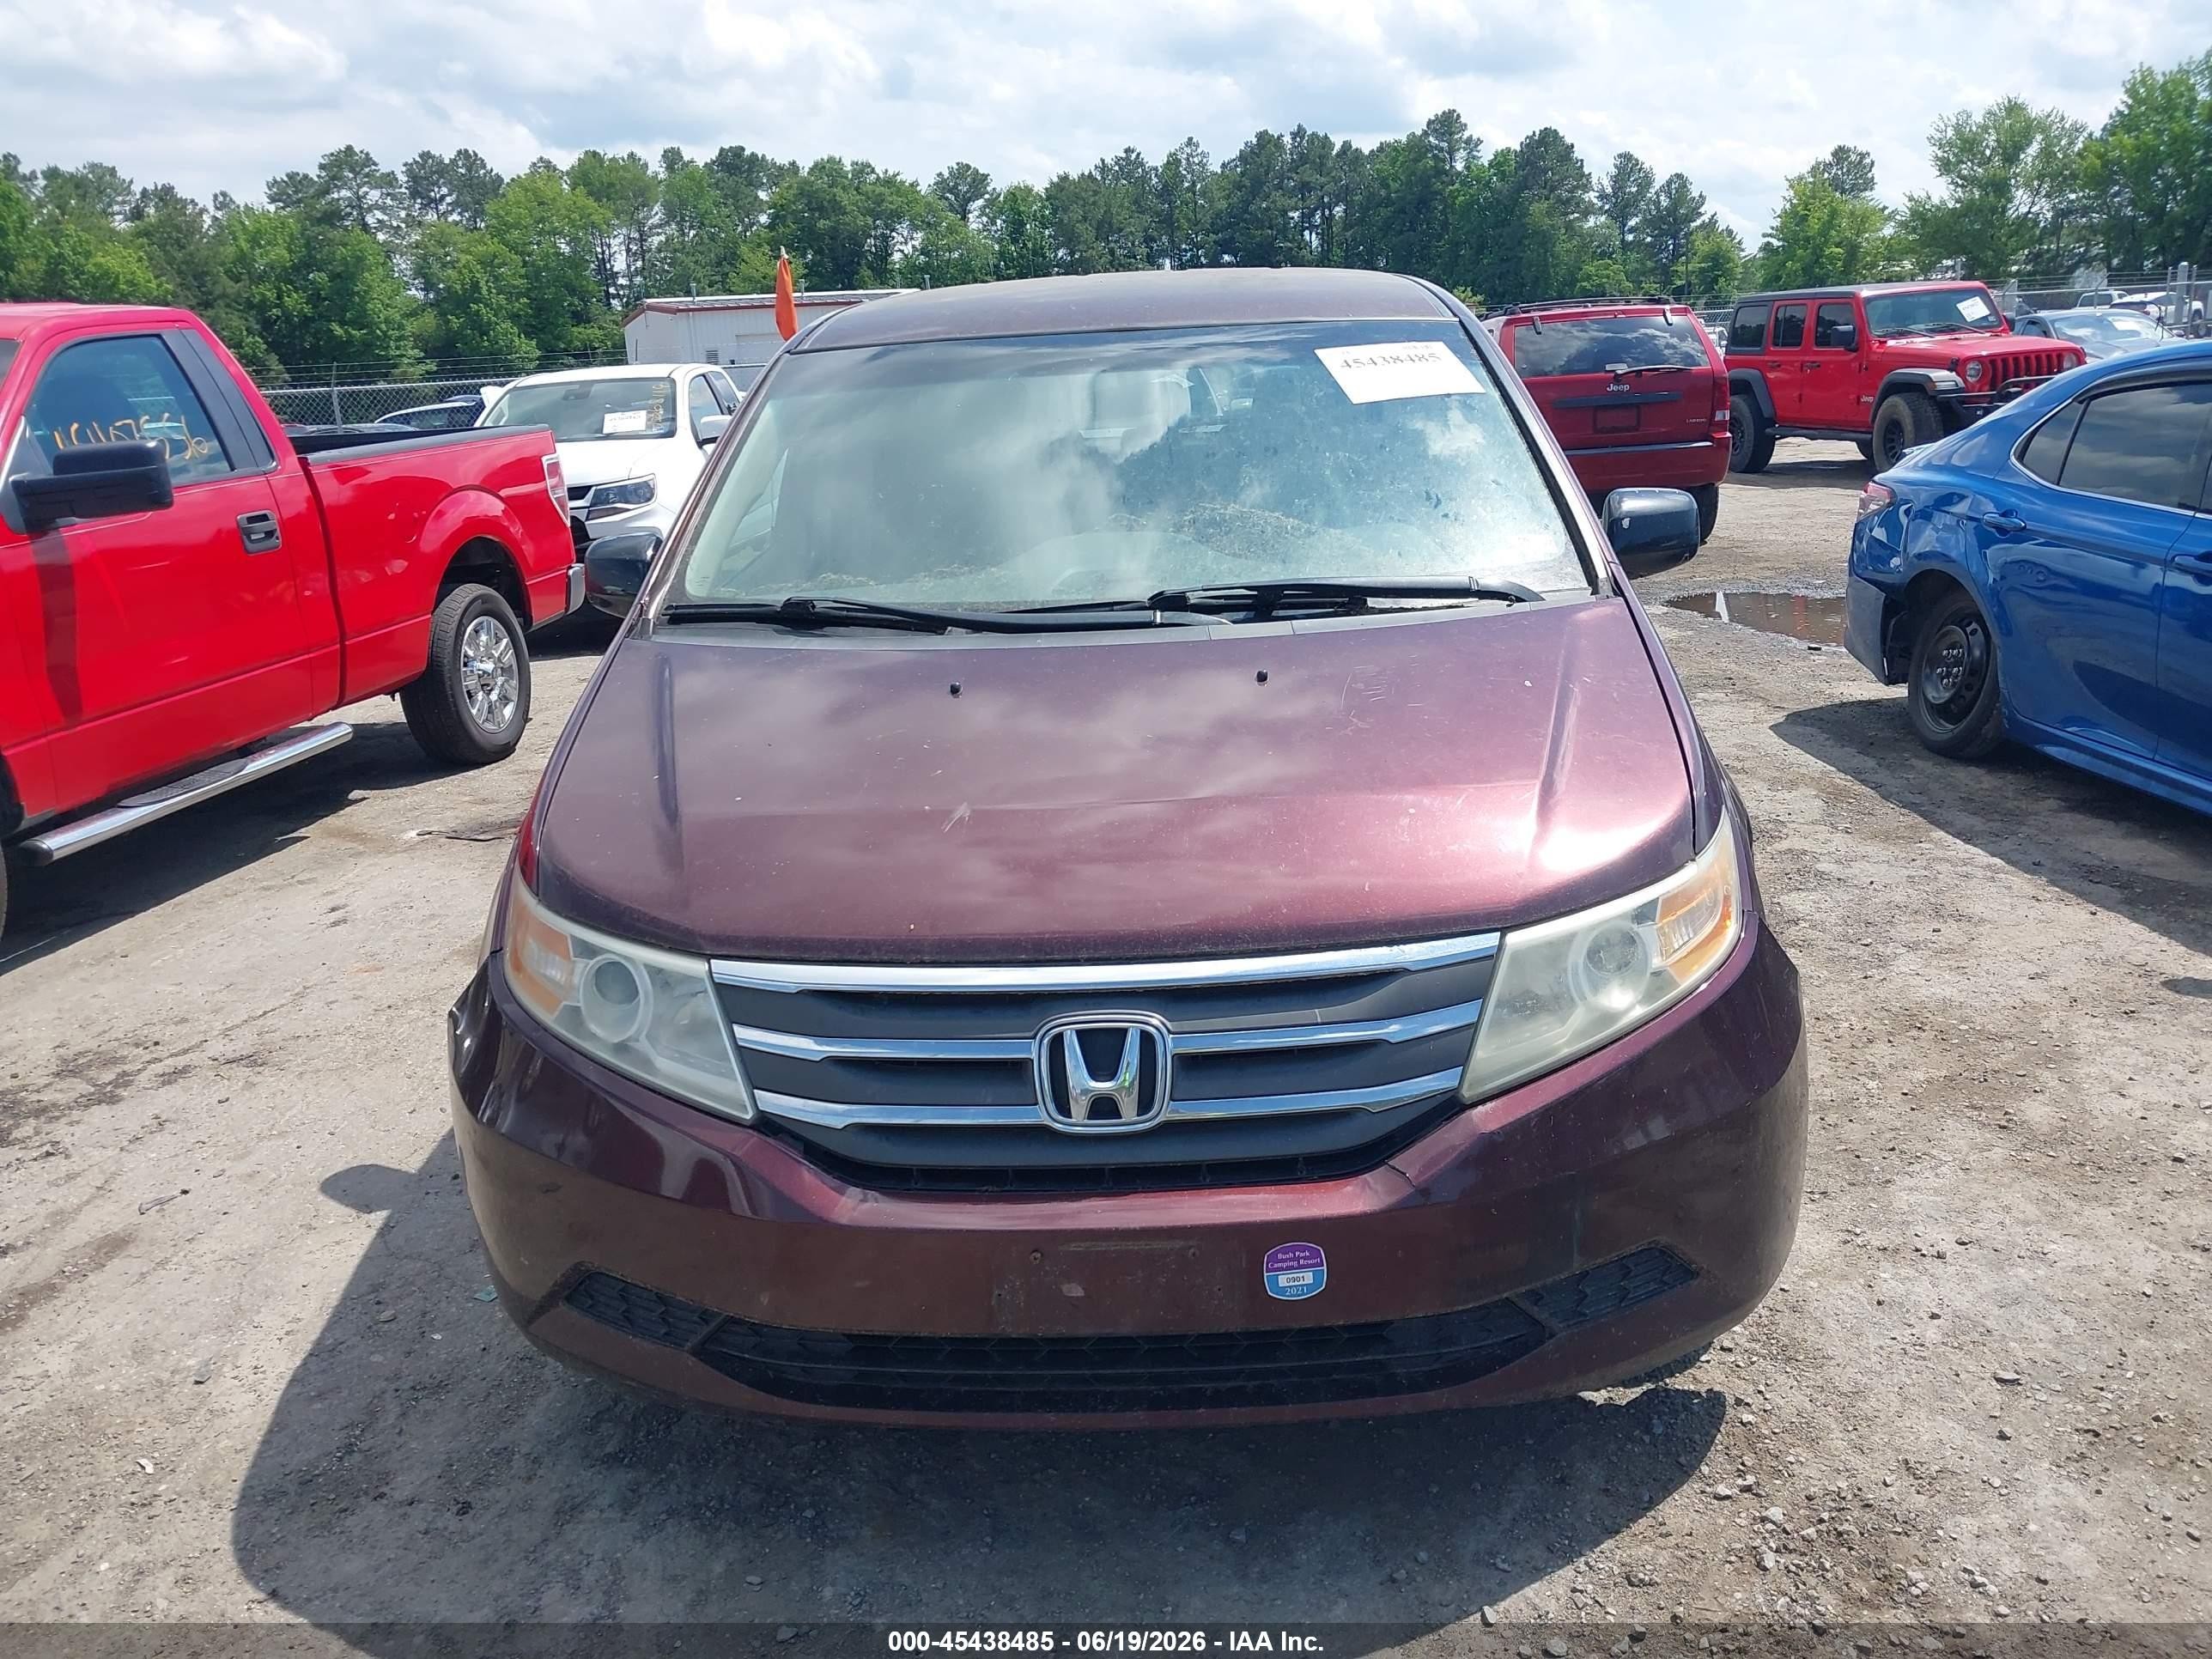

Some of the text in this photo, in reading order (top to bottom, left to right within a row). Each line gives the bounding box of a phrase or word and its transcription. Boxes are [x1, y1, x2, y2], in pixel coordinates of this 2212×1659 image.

[1340, 353, 1442, 369] 45438485
[1607, 384, 1630, 392] Jeep
[1268, 1260, 1298, 1268] Camping
[1285, 1275, 1305, 1284] 0901
[1285, 1286, 1307, 1295] 2021
